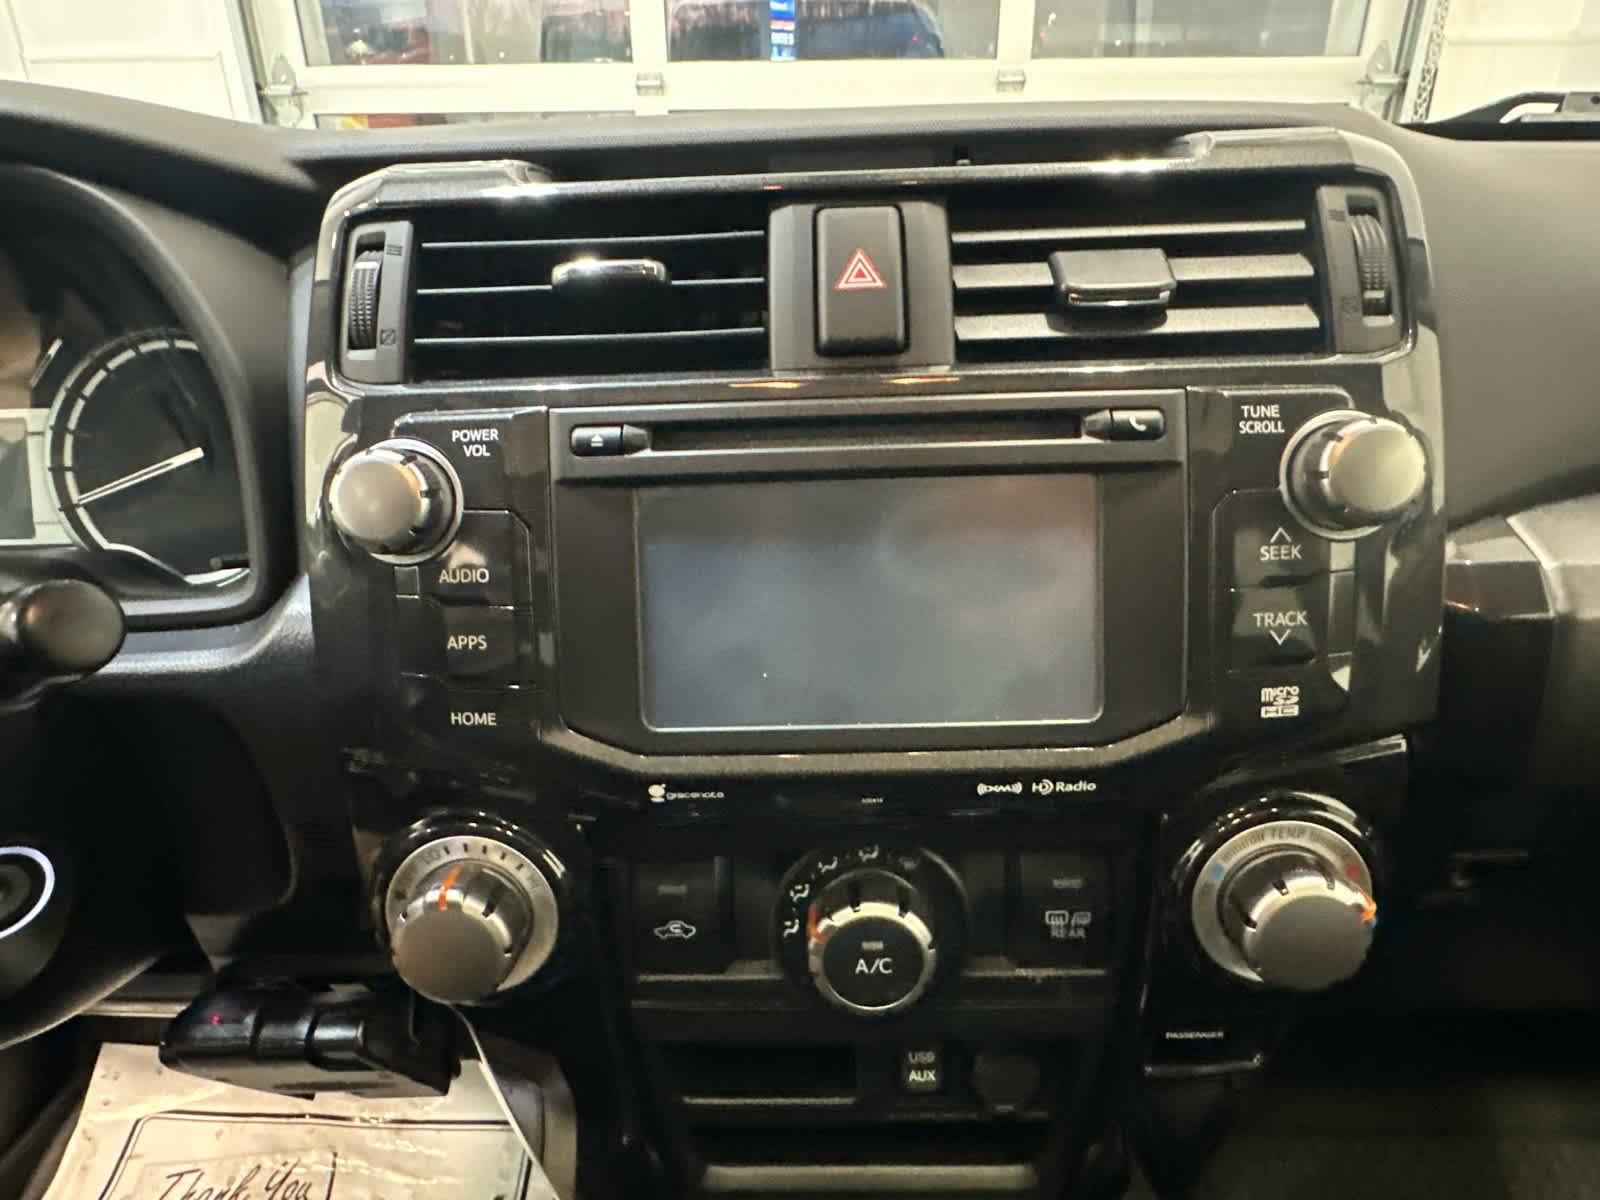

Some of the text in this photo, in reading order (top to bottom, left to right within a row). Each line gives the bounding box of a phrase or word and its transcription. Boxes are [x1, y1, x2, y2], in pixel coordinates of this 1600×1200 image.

[1240, 405, 1280, 418] TUNE
[1239, 420, 1285, 434] SCROLL
[451, 429, 499, 442] POWER
[463, 444, 491, 457] VOL
[1260, 545, 1302, 561] SEEK
[438, 568, 490, 584] AUDIO
[1253, 610, 1308, 628] TRACK
[447, 635, 488, 650] APPS
[450, 712, 498, 726] HOME
[1055, 780, 1097, 793] Radio
[855, 957, 894, 974] A/C
[908, 1070, 937, 1082] AUX
